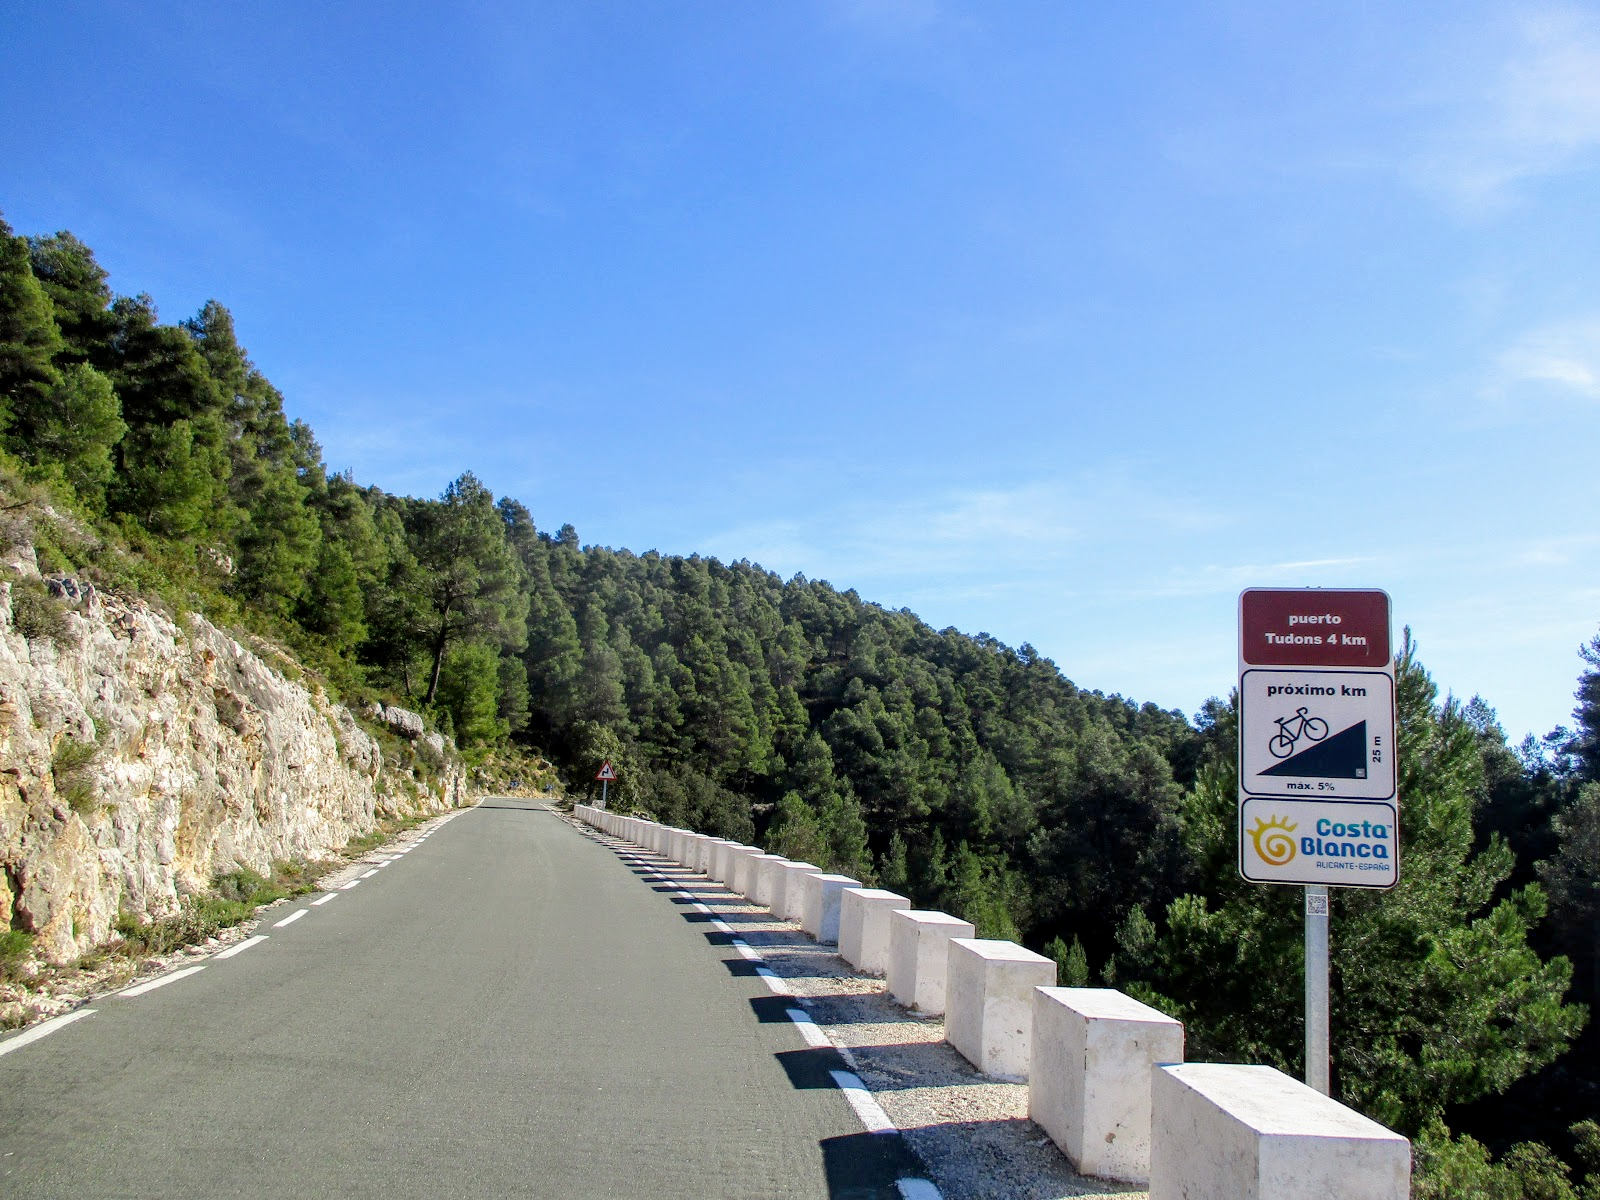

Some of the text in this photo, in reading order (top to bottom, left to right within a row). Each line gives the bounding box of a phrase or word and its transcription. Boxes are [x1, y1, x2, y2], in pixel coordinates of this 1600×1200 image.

[1288, 613, 1341, 626] puerto
[1265, 632, 1366, 646] Tudons 4 km
[1267, 683, 1366, 697] próximo km
[1372, 736, 1381, 763] 25 m
[1318, 782, 1335, 791] 5%
[1316, 818, 1388, 839] Costa
[1301, 837, 1389, 859] Blanca
